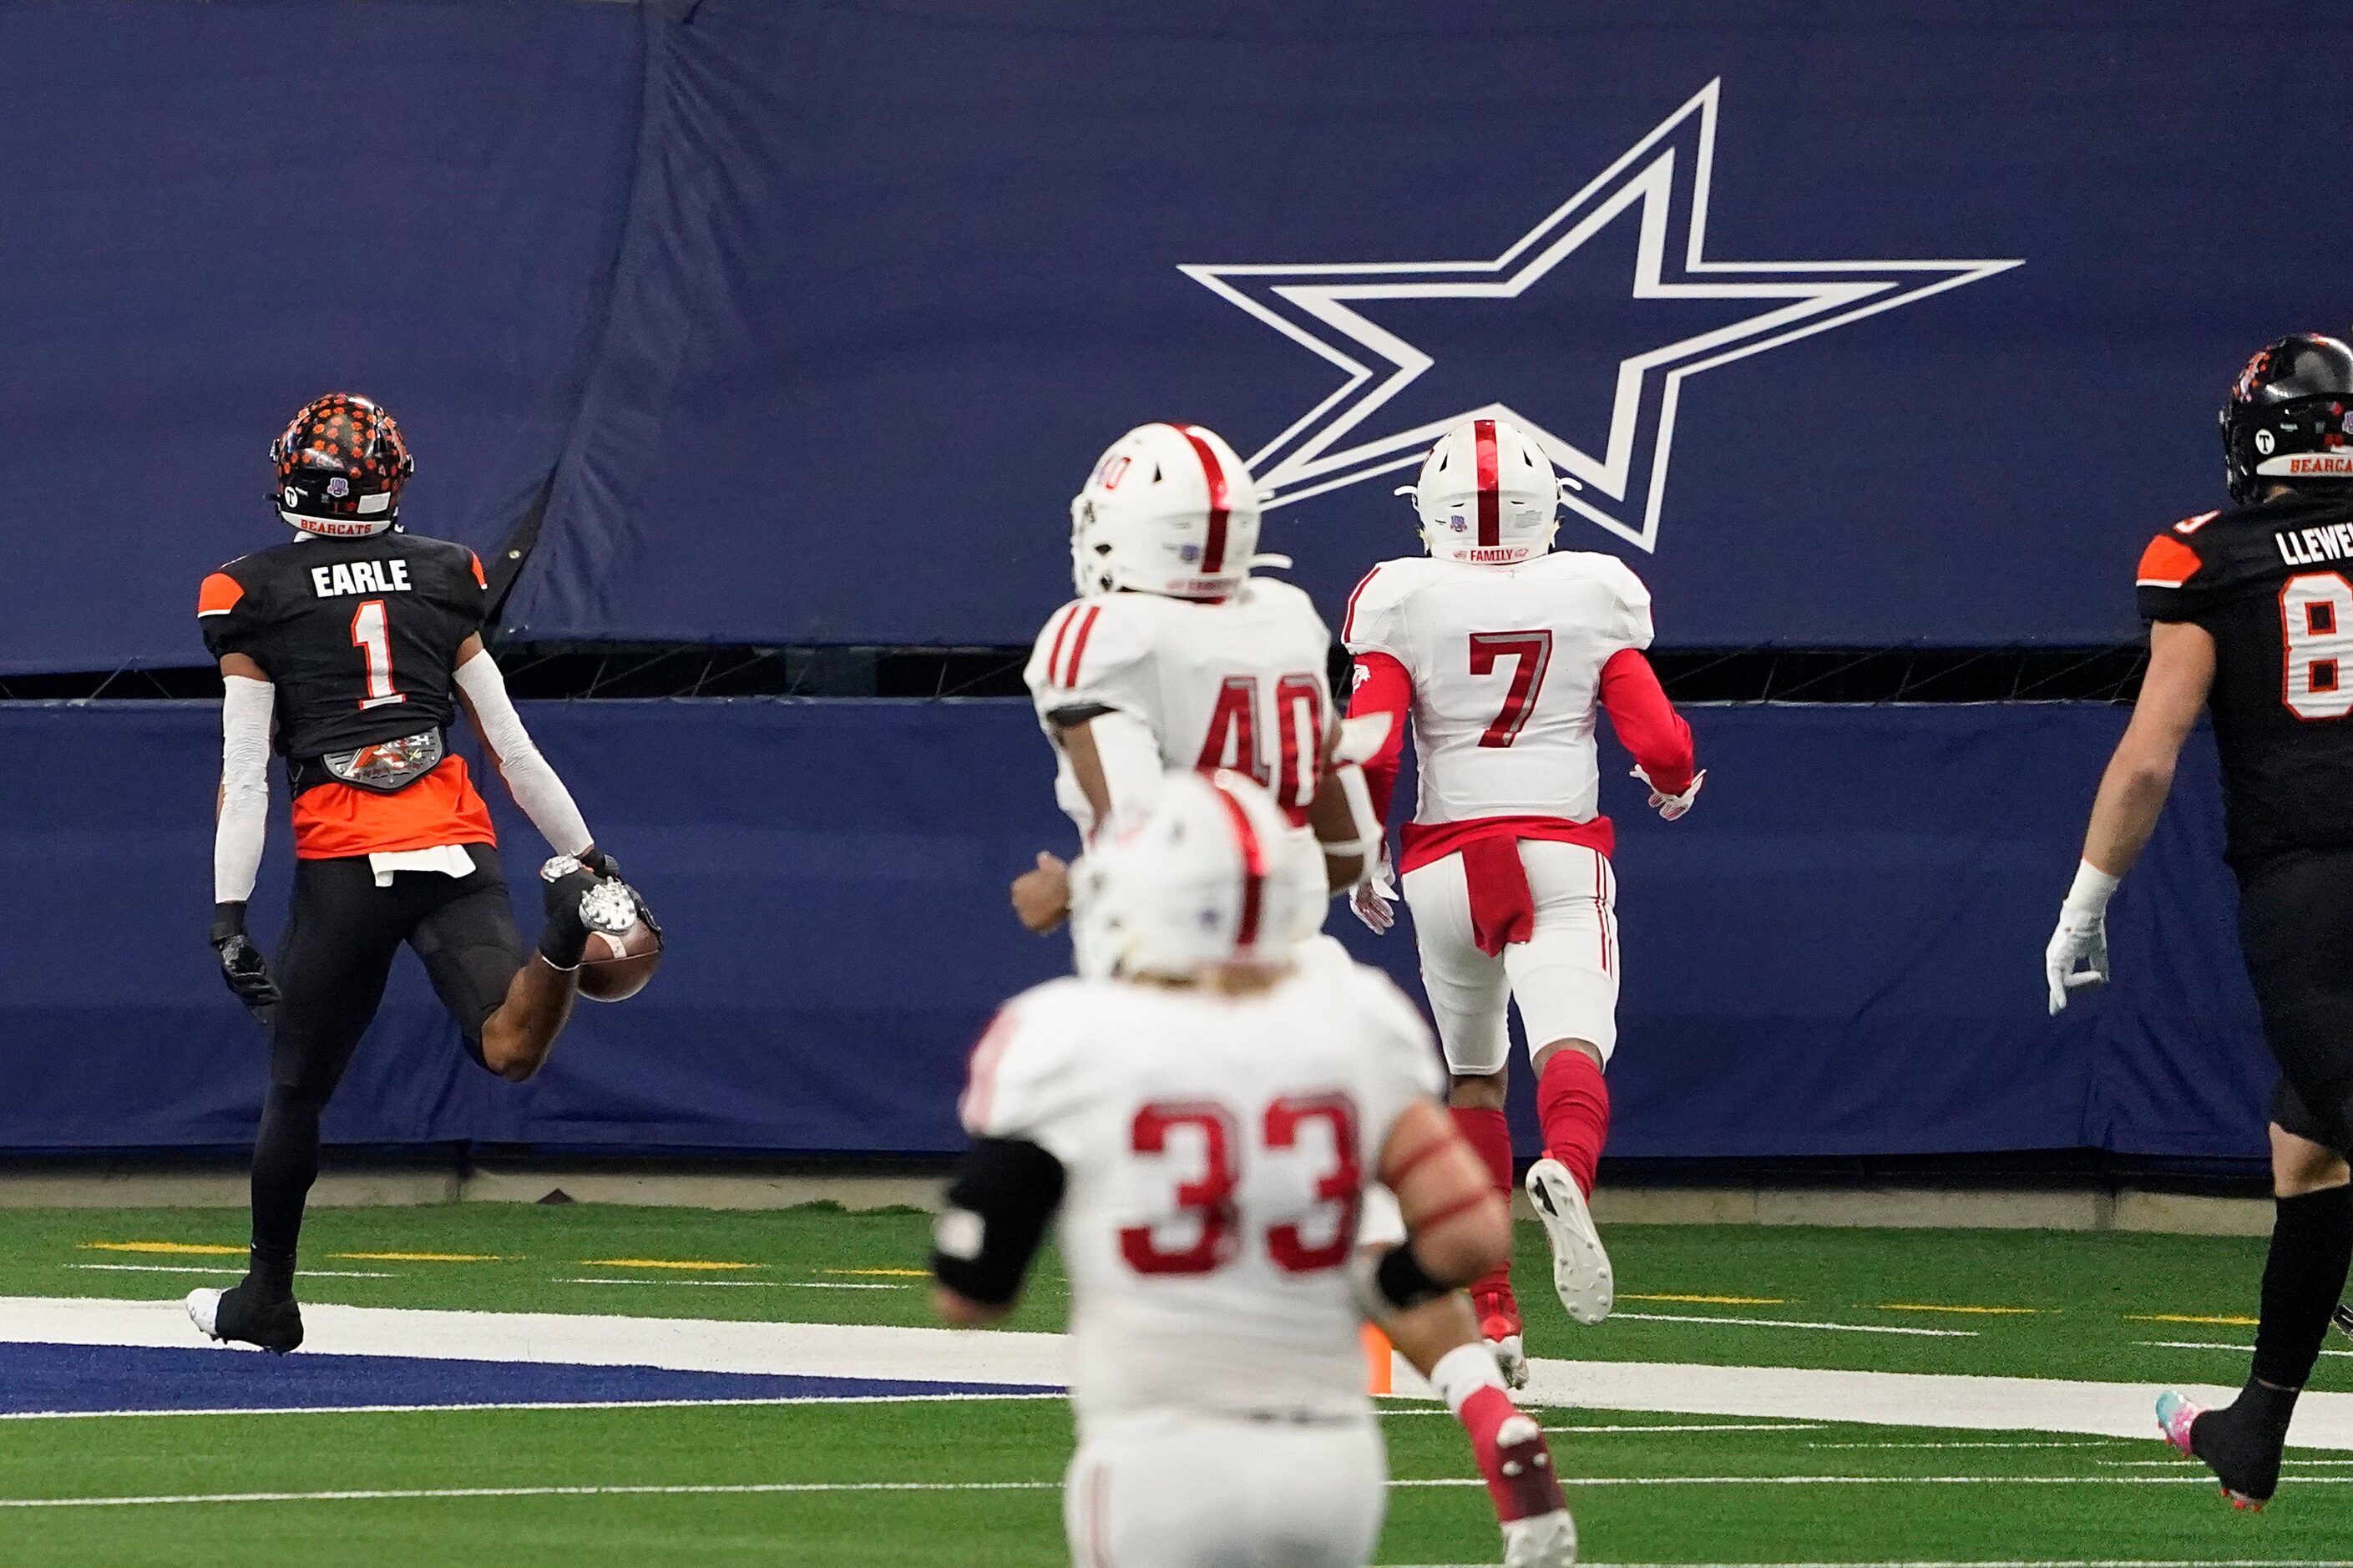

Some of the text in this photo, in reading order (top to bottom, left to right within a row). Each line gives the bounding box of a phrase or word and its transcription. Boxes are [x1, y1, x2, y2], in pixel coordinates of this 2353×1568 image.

[2259, 435, 2270, 453] T
[301, 519, 372, 535] BEARCATS
[1470, 549, 1513, 561] FAMILY
[311, 559, 412, 598] EARLE
[351, 599, 407, 711] 1
[1470, 630, 1552, 748] 7
[1195, 674, 1323, 827] 40
[1119, 1091, 1363, 1274] 33
